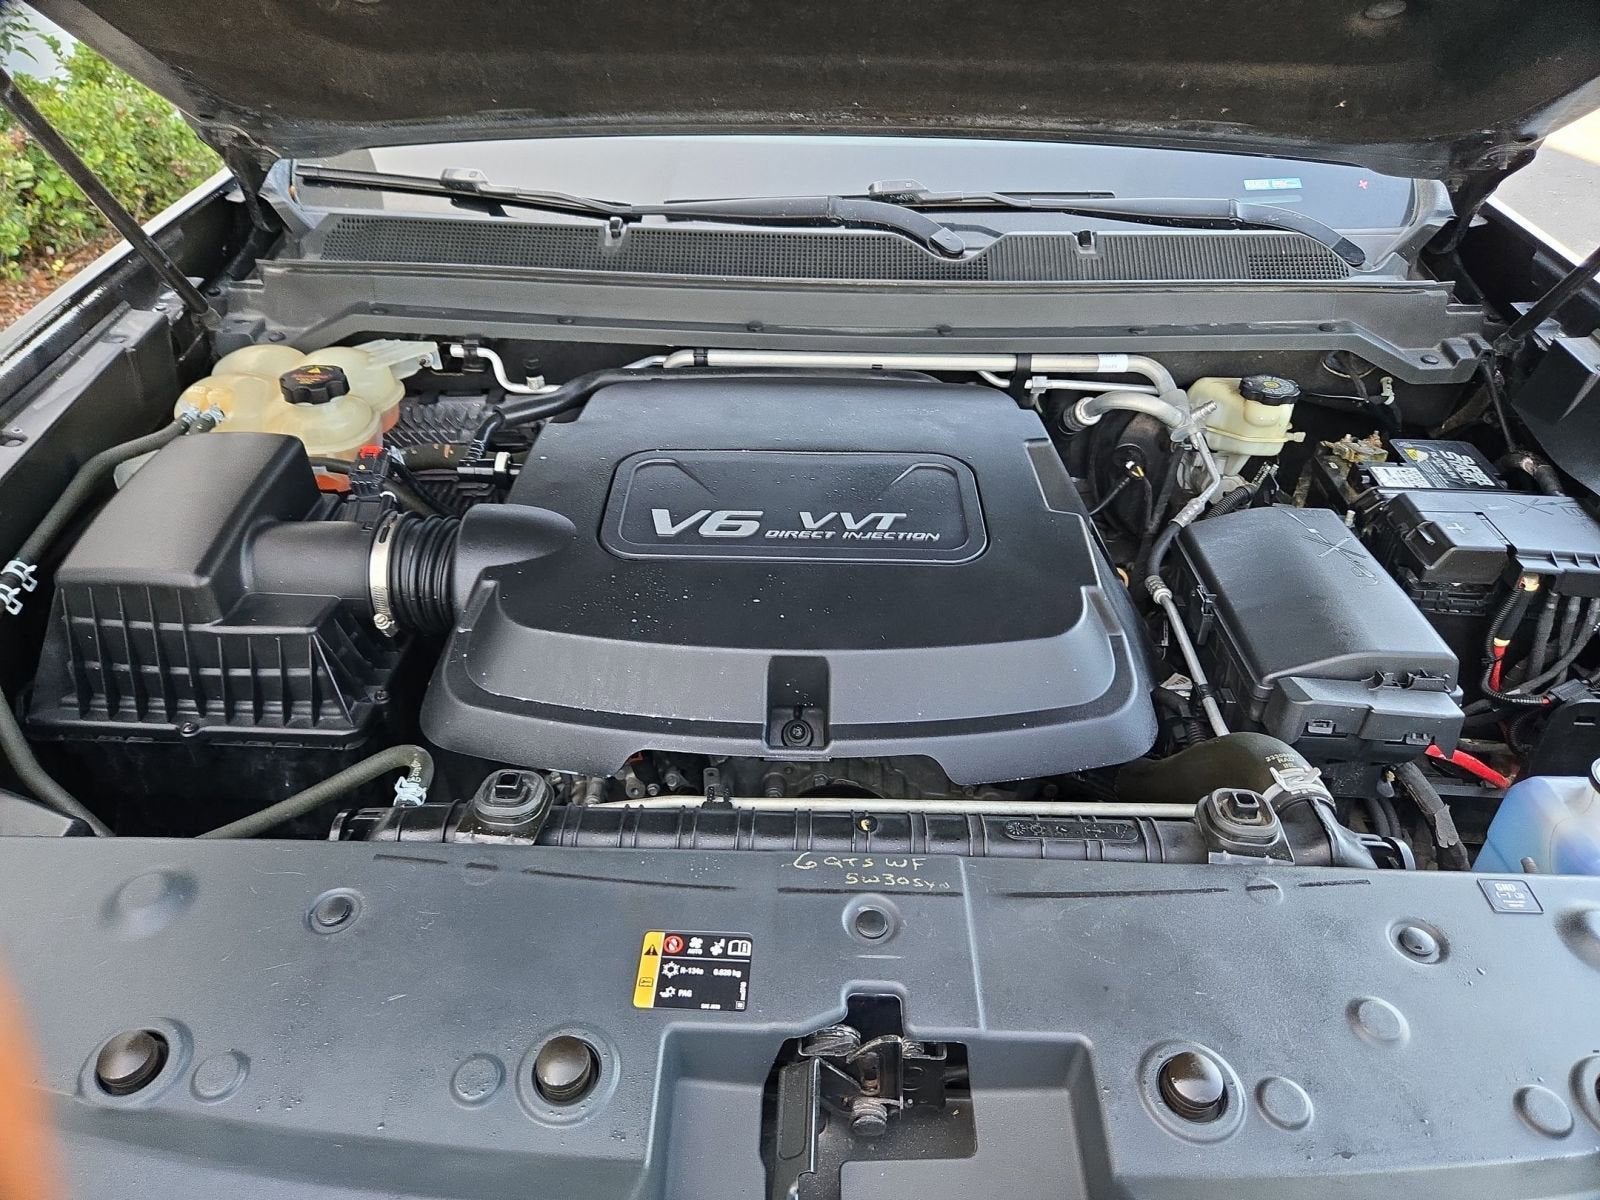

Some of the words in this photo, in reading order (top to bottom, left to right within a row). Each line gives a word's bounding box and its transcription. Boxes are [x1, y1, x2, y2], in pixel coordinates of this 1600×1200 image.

[1439, 450, 1478, 484] START
[1460, 455, 1496, 486] SUPER
[651, 508, 763, 537] V6
[800, 511, 907, 530] VVT
[764, 530, 836, 539] DIRECT
[842, 531, 940, 541] INJECTION
[793, 852, 817, 869] 6
[678, 989, 693, 998] PAG
